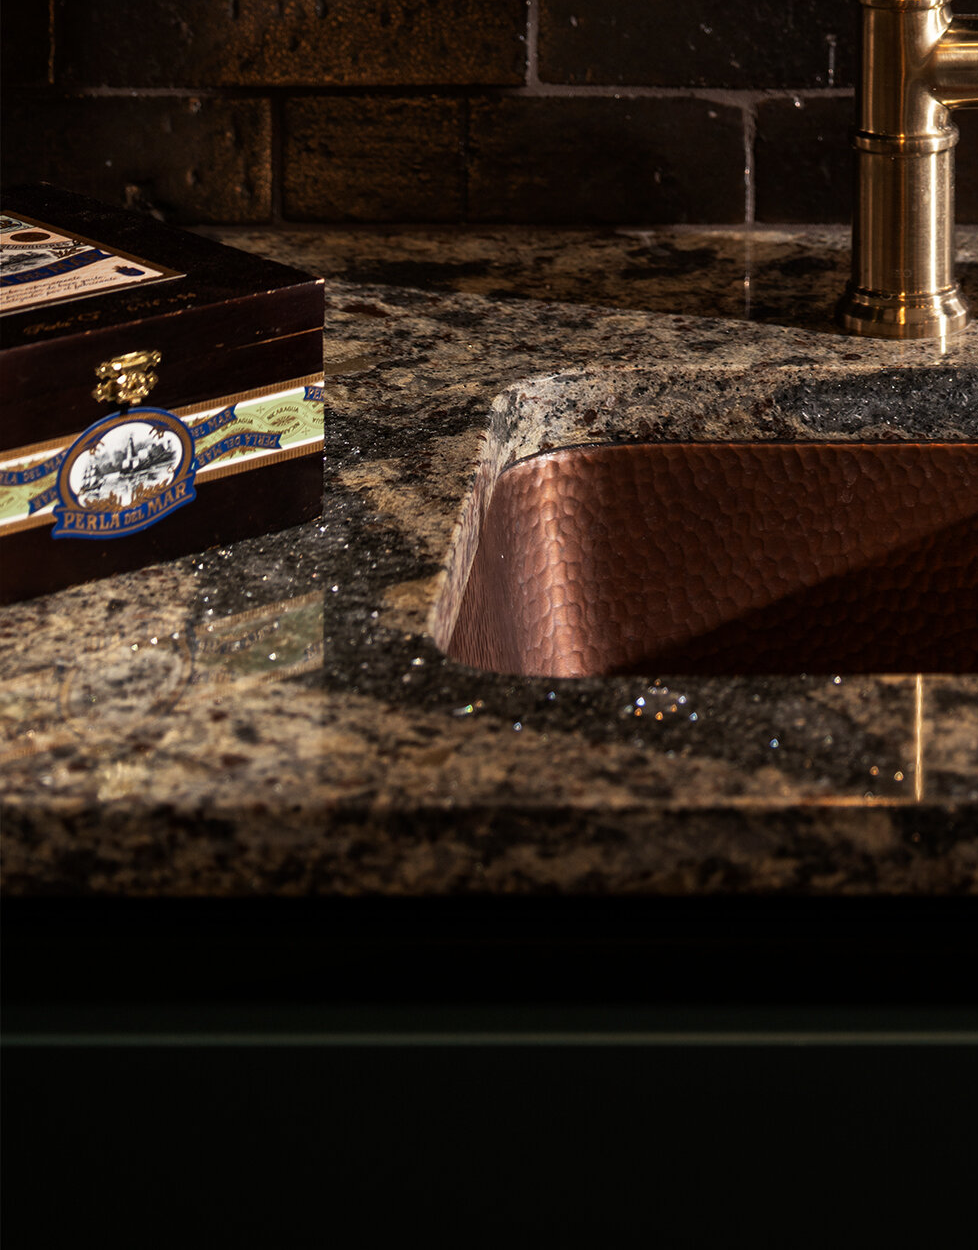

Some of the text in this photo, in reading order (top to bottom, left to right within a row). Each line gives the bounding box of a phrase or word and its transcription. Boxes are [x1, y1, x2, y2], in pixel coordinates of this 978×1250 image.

[207, 410, 232, 431] MAR
[23, 467, 42, 480] DEL
[63, 481, 187, 530] PERLA DEL MAR
